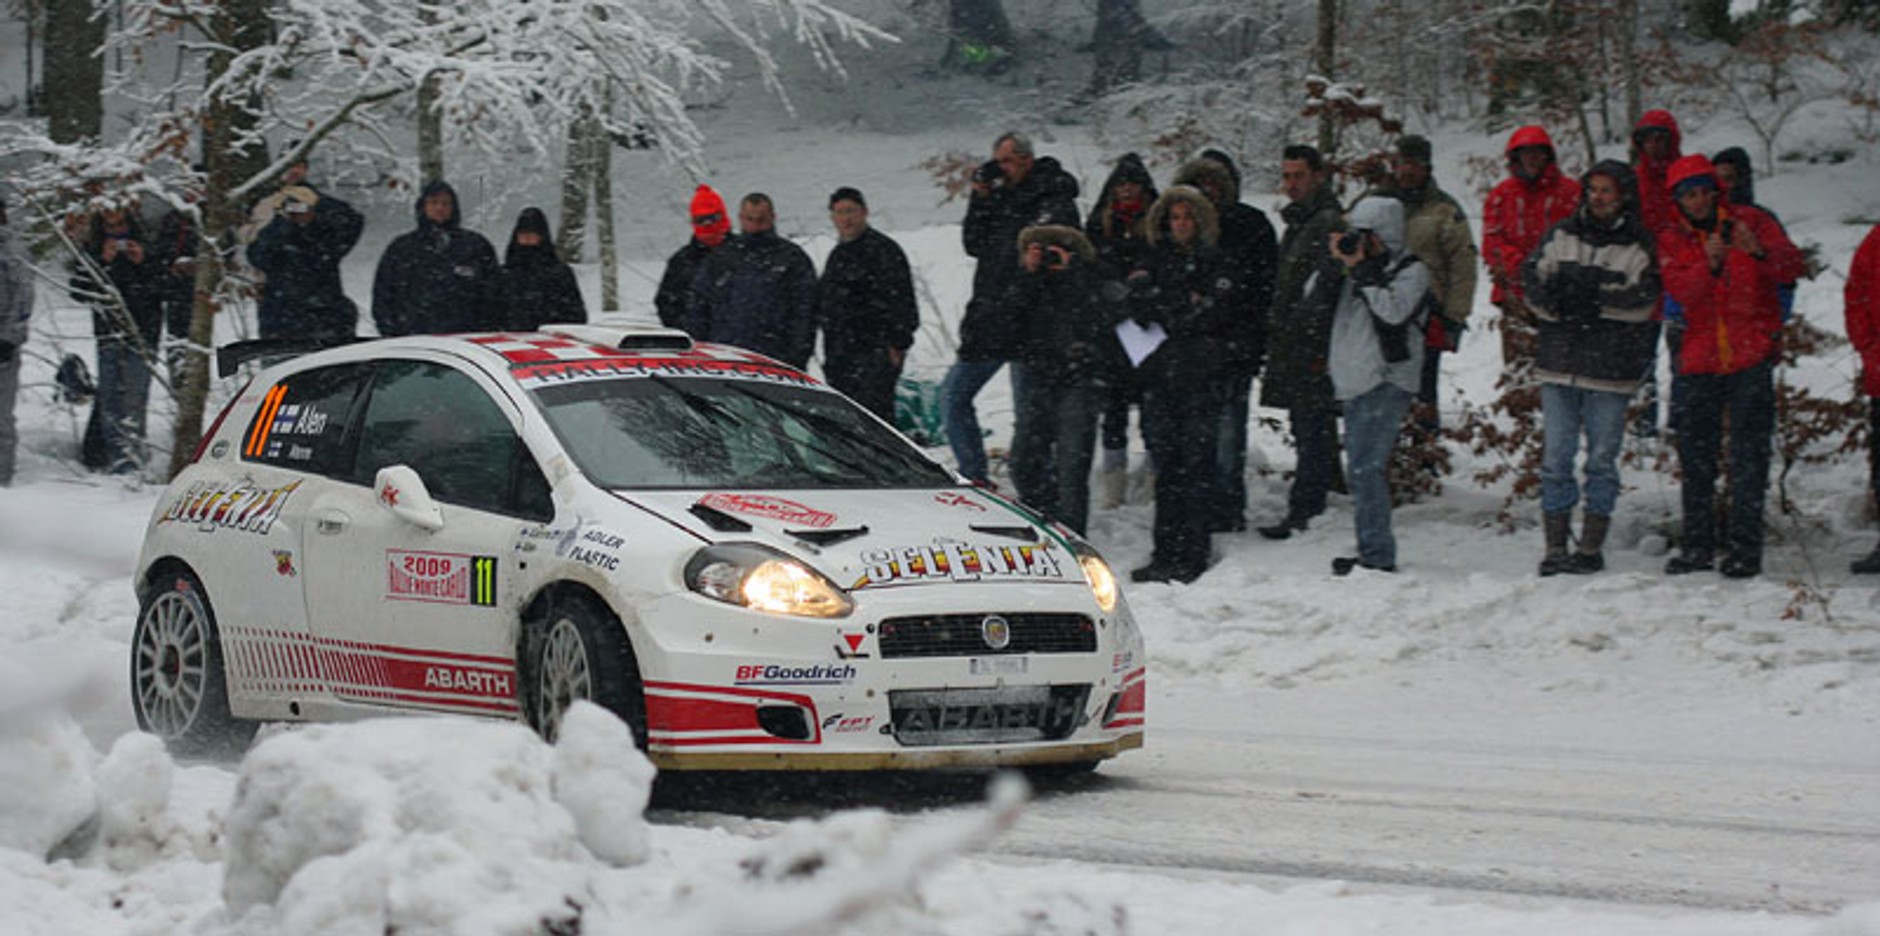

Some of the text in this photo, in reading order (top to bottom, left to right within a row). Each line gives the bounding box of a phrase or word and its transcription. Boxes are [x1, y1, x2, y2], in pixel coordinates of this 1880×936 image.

[245, 384, 288, 456] 11
[583, 529, 626, 549] ADLER
[404, 556, 451, 577] 2009
[568, 545, 620, 571] PLASTIC
[860, 545, 1064, 582] SELENIA
[475, 556, 494, 604] 11
[424, 667, 511, 695] ABARTH
[735, 663, 857, 681] BFGoodrich
[901, 698, 1084, 733] ABARTH
